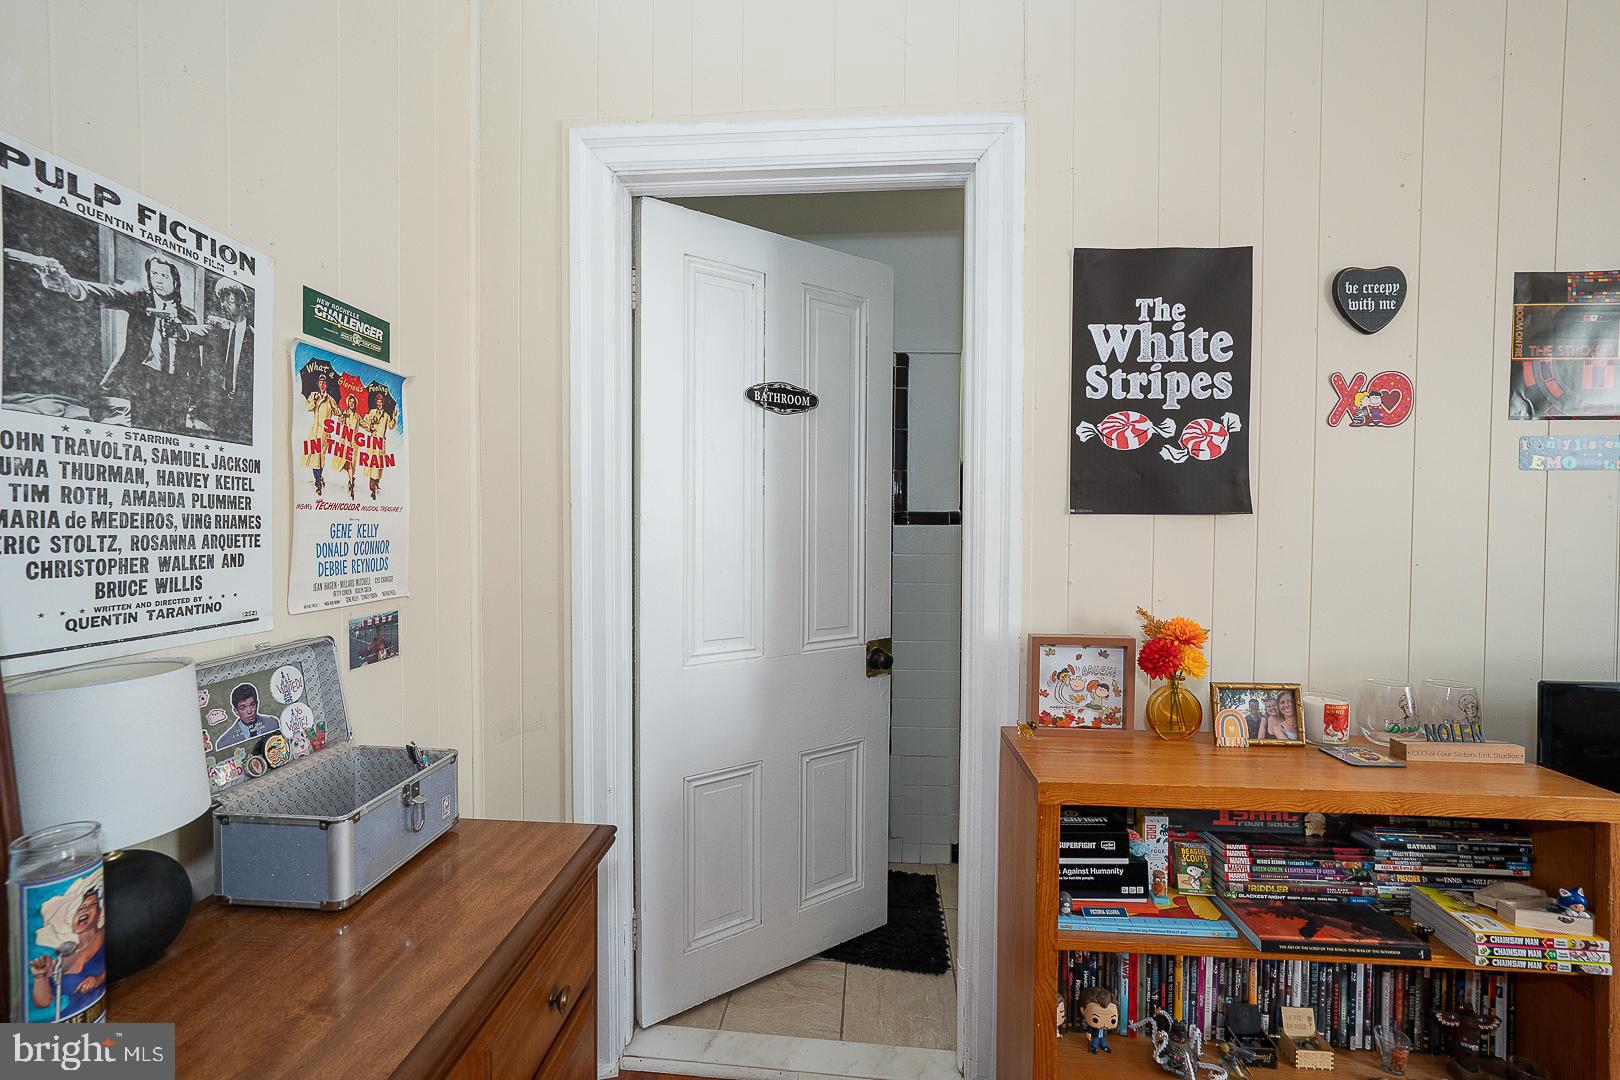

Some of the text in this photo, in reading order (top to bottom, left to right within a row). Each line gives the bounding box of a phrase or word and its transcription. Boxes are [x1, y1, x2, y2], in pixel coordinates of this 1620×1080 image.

[0, 142, 256, 276] PULP FICTION
[59, 196, 225, 272] A QUENTIN TARANTINO FILM
[1345, 281, 1400, 296] be creepy
[317, 298, 360, 319] NEW ROCHELLE
[1136, 297, 1186, 322] The
[1348, 297, 1397, 312] with me
[314, 304, 384, 340] CHALLENGER
[1088, 321, 1234, 363] White
[1515, 331, 1524, 343] ON
[1528, 345, 1553, 356] THE
[306, 362, 329, 374] What
[338, 376, 364, 393] Glorious
[368, 384, 388, 395] Feeling
[1085, 363, 1233, 410] Stripes
[754, 390, 811, 406] BATHROOM
[1328, 371, 1414, 427] XO
[124, 431, 180, 446] STARRING
[323, 419, 384, 450] SINGIN
[0, 430, 261, 474] OHN TRAVOLTA, SAMUEL JACKSON
[303, 438, 396, 468] IN THE RAIN
[1529, 455, 1577, 470] EMO
[0, 455, 255, 492] UMA THURMAN, HARVEY KEITEL
[8, 483, 252, 511] TIM ROTH, AMANDA PLUMMER
[315, 499, 361, 511] TECHNICOLOR
[65, 511, 87, 529] de
[91, 511, 178, 532] MEDEIROS,
[182, 513, 212, 530] VING
[214, 515, 262, 530] RHAMES
[330, 523, 379, 539] GENE KELLY
[0, 533, 261, 555] RIC STOLTZ, ROSANNA ARQUETTE
[316, 540, 390, 558] DONALD O'CONNOR
[25, 553, 245, 580] CHRISTOPHER WALKEN AND
[318, 557, 389, 577] DEBBIE REYNOLDS
[94, 575, 203, 600] BRUCE WILLIS
[94, 603, 132, 614] WRITTEN
[135, 601, 152, 609] AND
[155, 597, 191, 607] DIRECTED
[242, 610, 258, 618] (252)
[65, 601, 222, 632] QUENTIN TARANTINO
[1059, 841, 1097, 849] SUPERFIGHT
[1181, 848, 1206, 856] BEAGLE
[1182, 854, 1208, 863] SCOUTS
[1063, 867, 1124, 876] Against Humanity
[1228, 873, 1250, 881] MARVEL
[1251, 884, 1289, 893] RIDDLER
[1490, 936, 1524, 945] CHAINSAW
[1524, 937, 1540, 946] MAN
[1493, 948, 1527, 957] CHAINSAW
[1527, 949, 1542, 958] MAN
[1492, 959, 1527, 969] CHAINSAW
[1527, 960, 1542, 970] MAN
